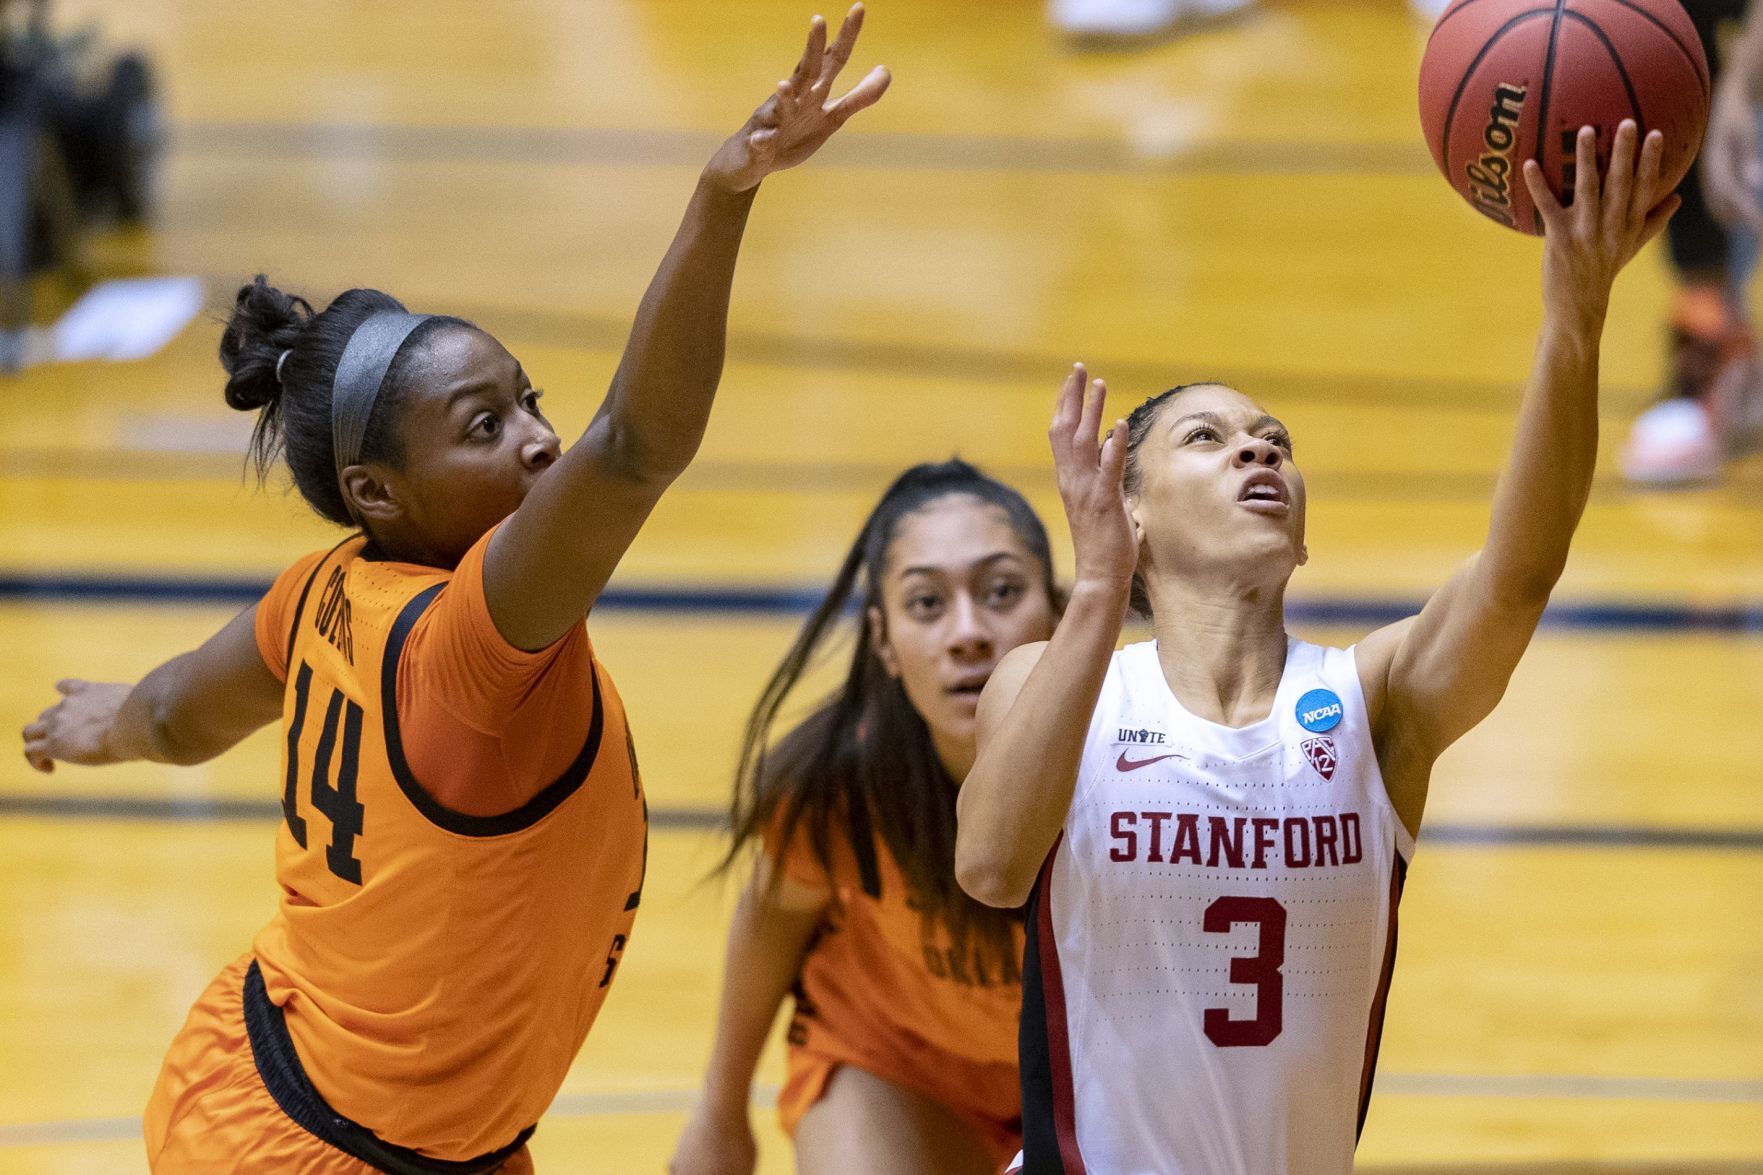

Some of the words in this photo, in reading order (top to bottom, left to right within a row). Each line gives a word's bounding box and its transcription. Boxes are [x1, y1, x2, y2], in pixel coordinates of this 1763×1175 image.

[1303, 703, 1341, 725] NCAA
[282, 658, 365, 886] 14
[1302, 738, 1336, 764] PAC
[1314, 755, 1334, 772] 12
[1109, 811, 1362, 869] STANFORD
[1203, 896, 1287, 1048] 3
